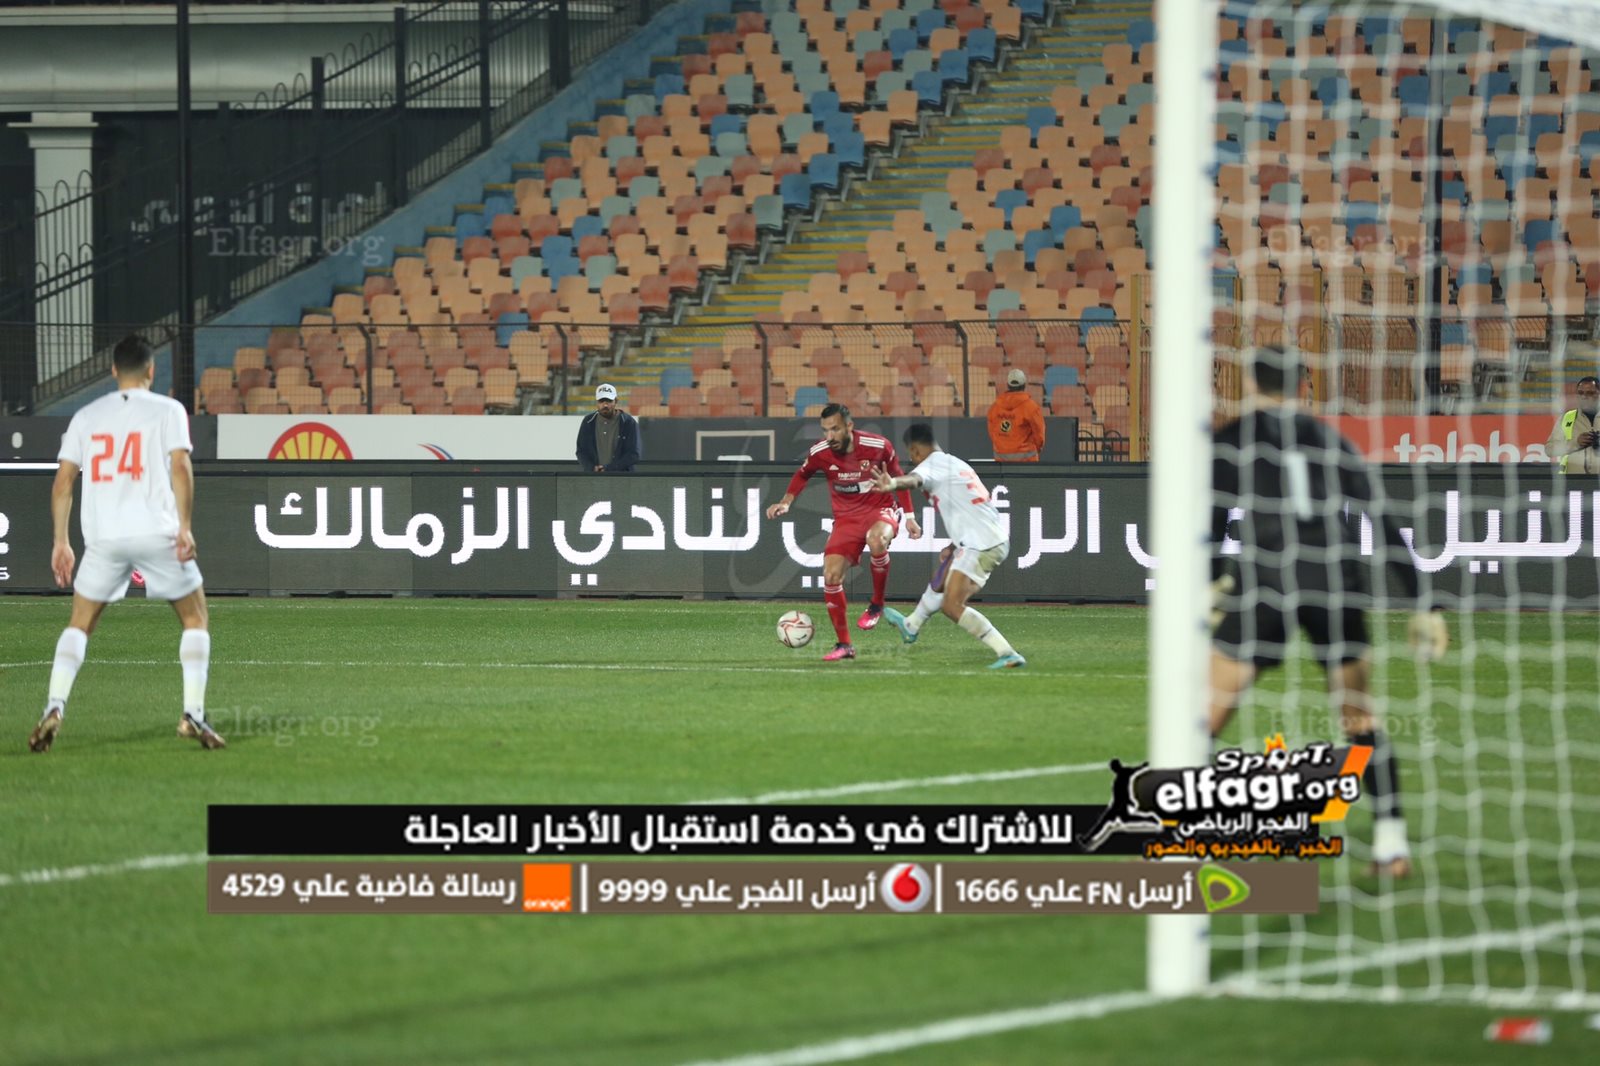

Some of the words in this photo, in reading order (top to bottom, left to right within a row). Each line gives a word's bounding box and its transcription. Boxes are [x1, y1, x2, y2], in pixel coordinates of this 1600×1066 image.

[90, 432, 143, 482] 24
[254, 487, 530, 565] الزمالك
[552, 487, 760, 586] لنادي
